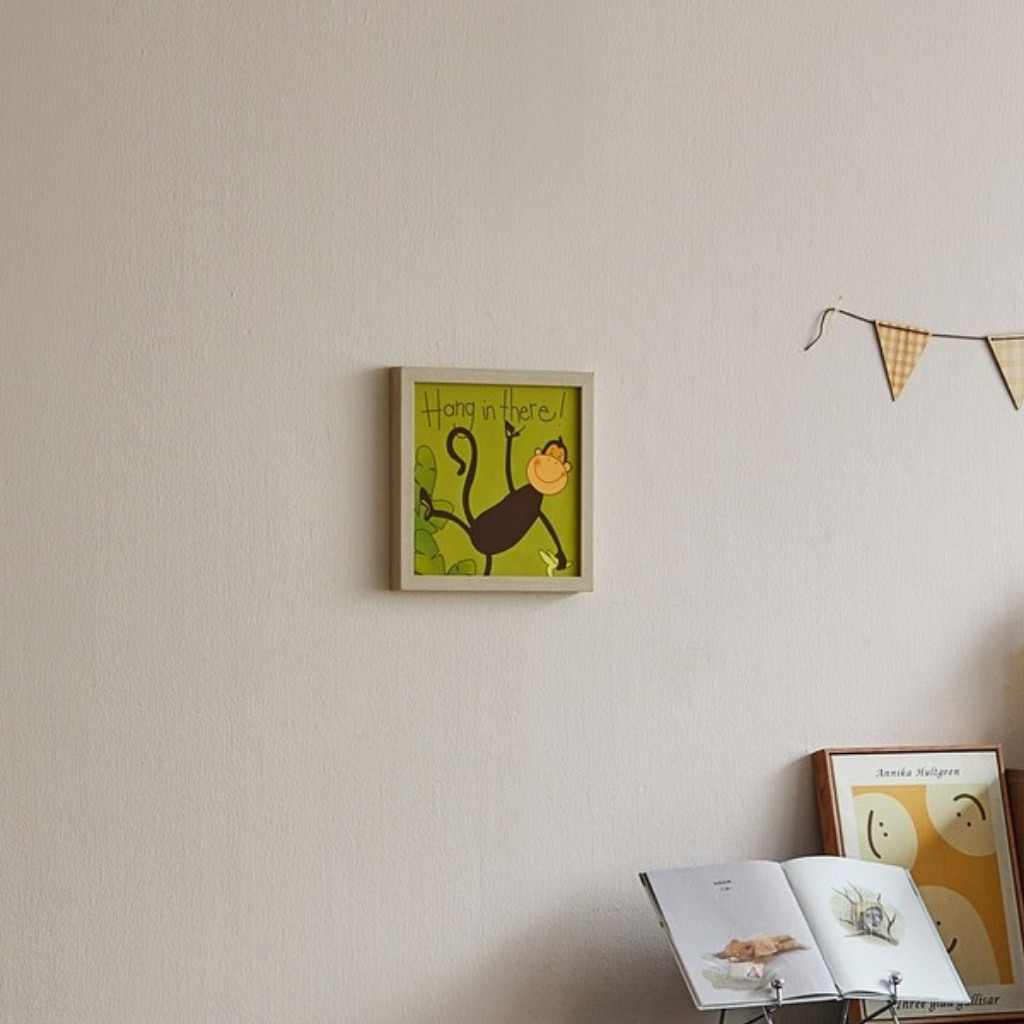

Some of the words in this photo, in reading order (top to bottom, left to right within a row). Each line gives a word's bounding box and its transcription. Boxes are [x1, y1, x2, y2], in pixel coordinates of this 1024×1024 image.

[422, 388, 476, 434] Hang
[482, 400, 496, 420] in
[500, 387, 567, 428] there!
[874, 767, 912, 779] Annika
